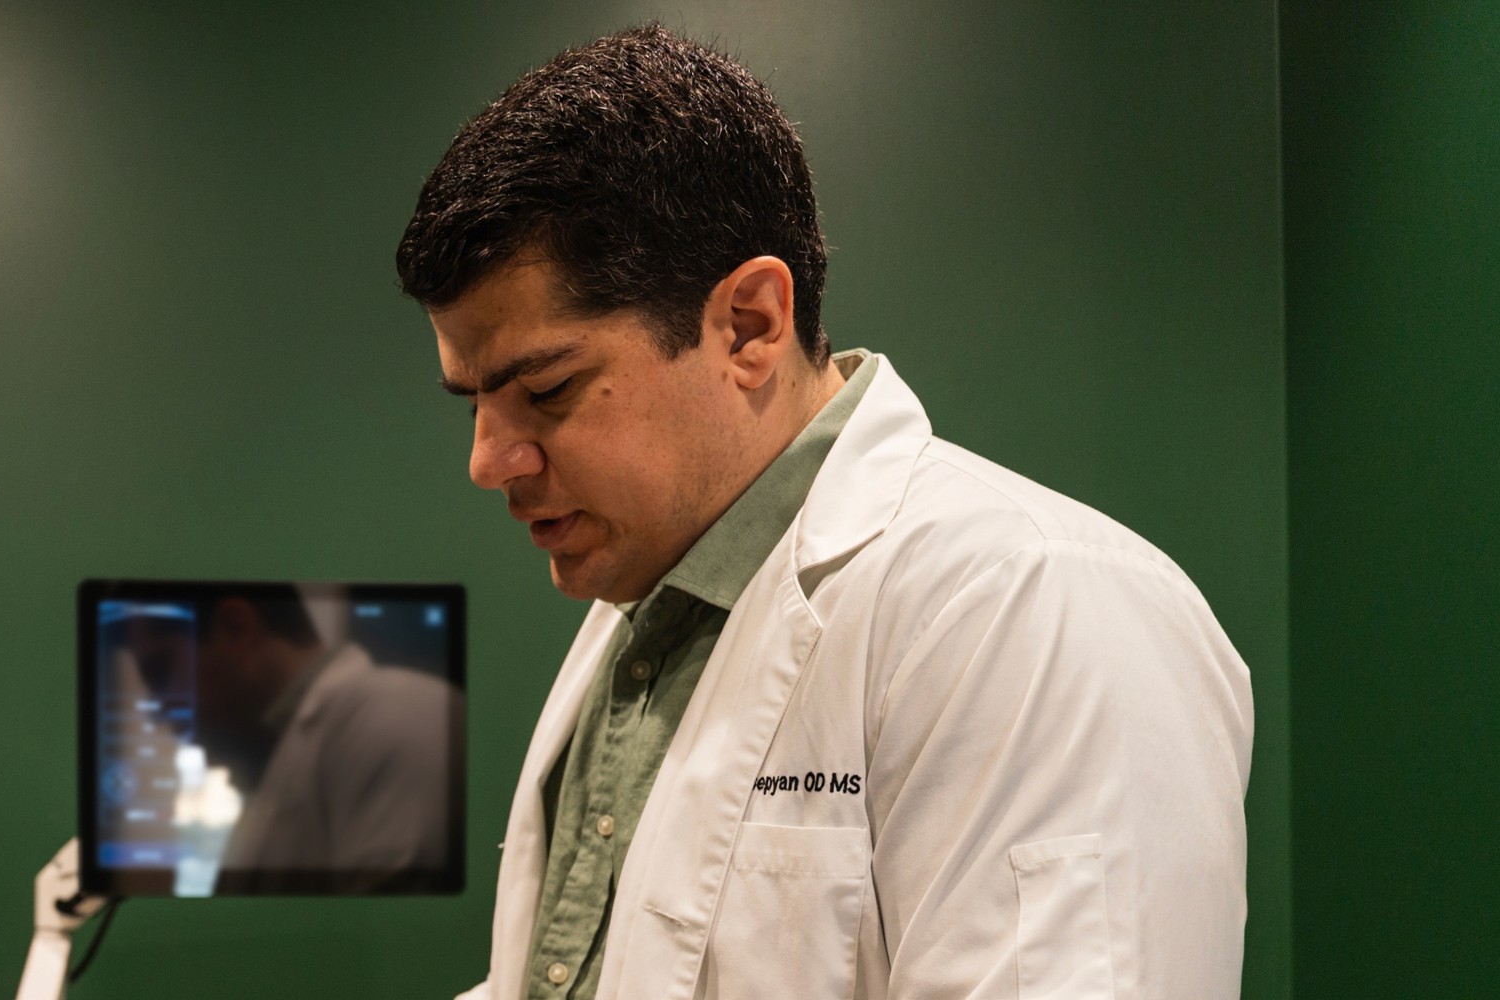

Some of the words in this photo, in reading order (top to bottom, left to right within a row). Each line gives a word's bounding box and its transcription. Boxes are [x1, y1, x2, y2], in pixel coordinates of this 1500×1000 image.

[753, 775, 799, 796] epyan
[804, 771, 825, 792] OD
[830, 772, 861, 794] MS
